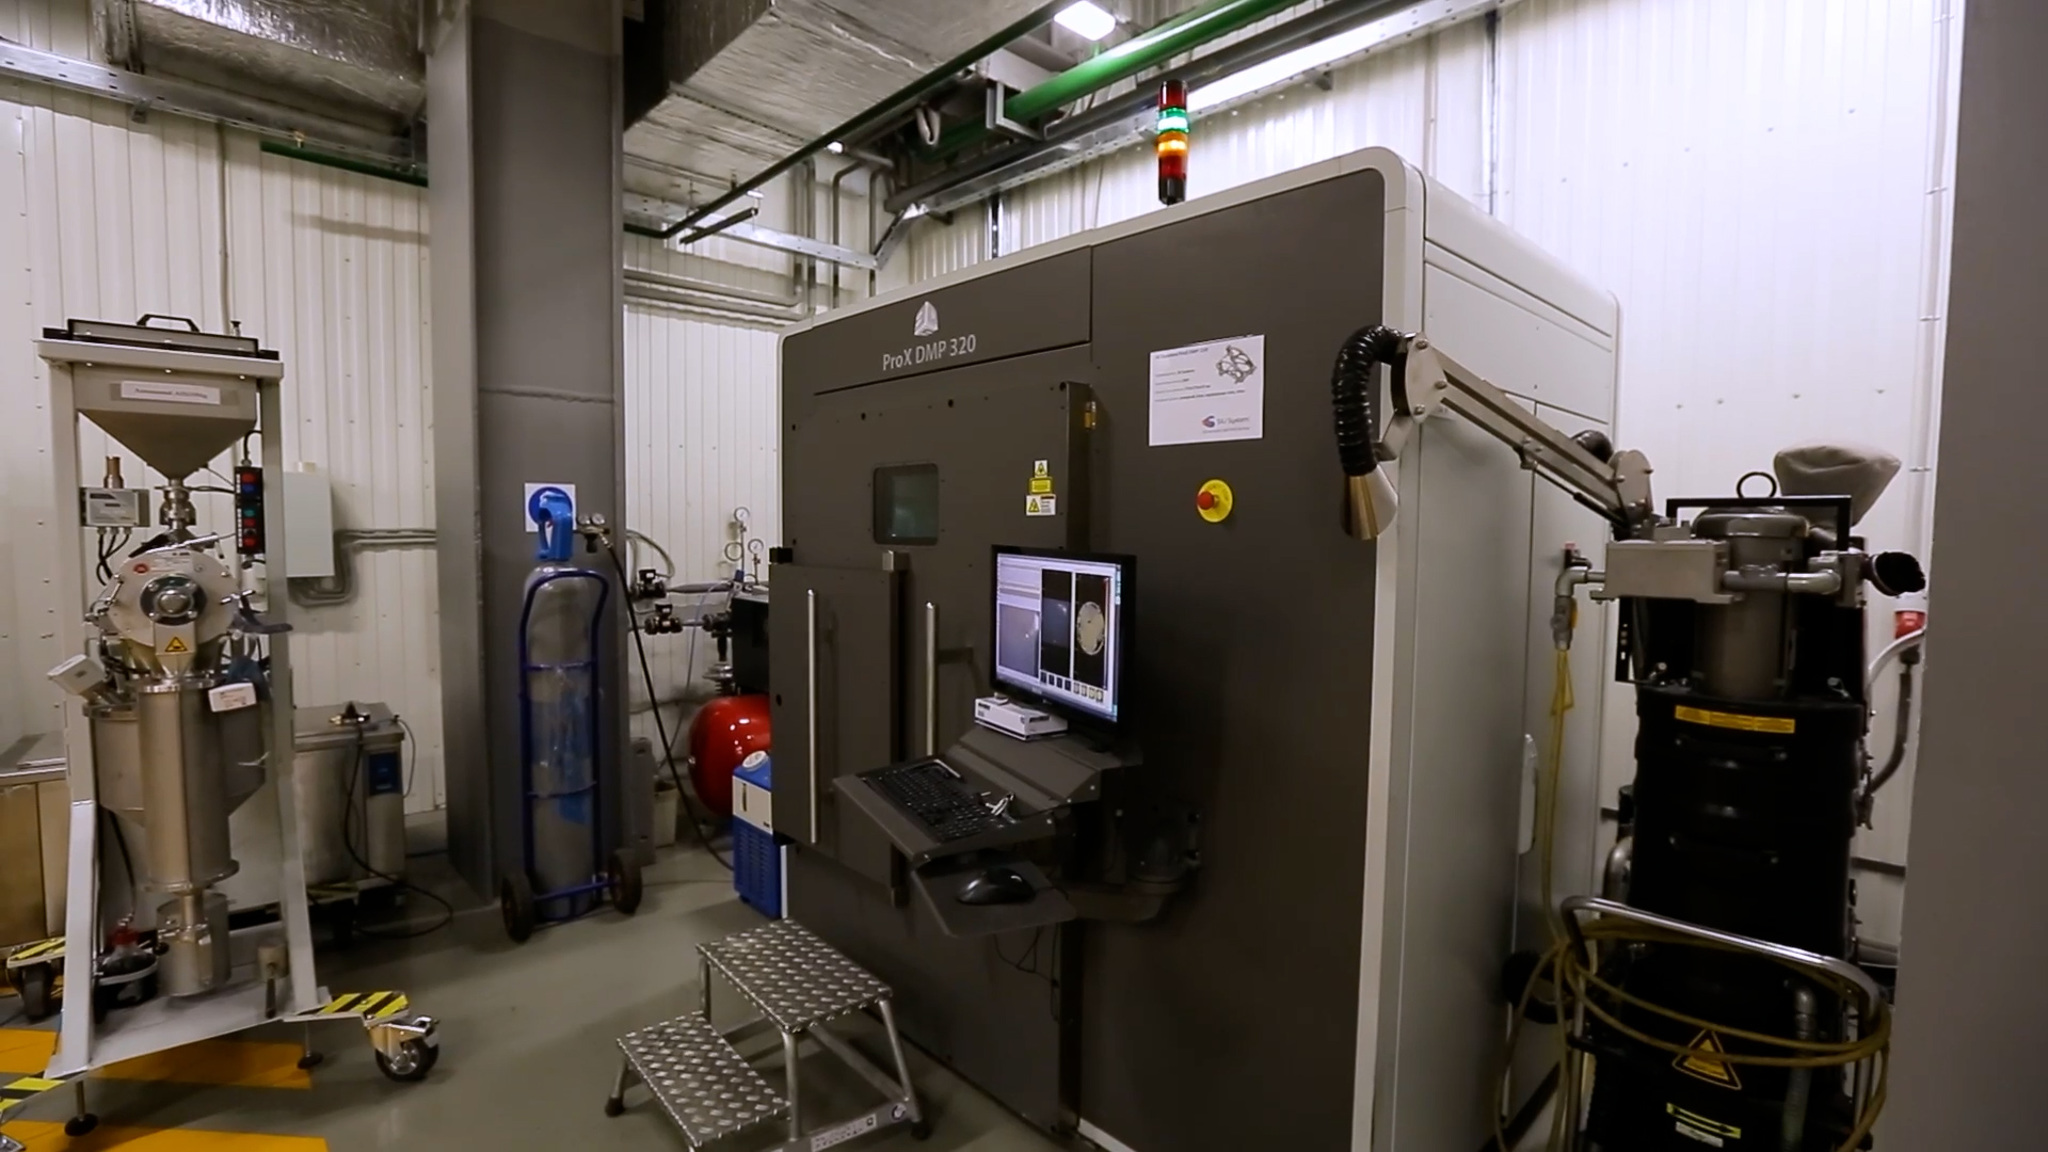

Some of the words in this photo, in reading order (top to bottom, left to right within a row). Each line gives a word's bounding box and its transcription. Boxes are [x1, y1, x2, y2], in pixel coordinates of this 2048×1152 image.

[883, 347, 912, 371] ProX
[915, 340, 947, 364] DMP
[949, 334, 976, 356] 320
